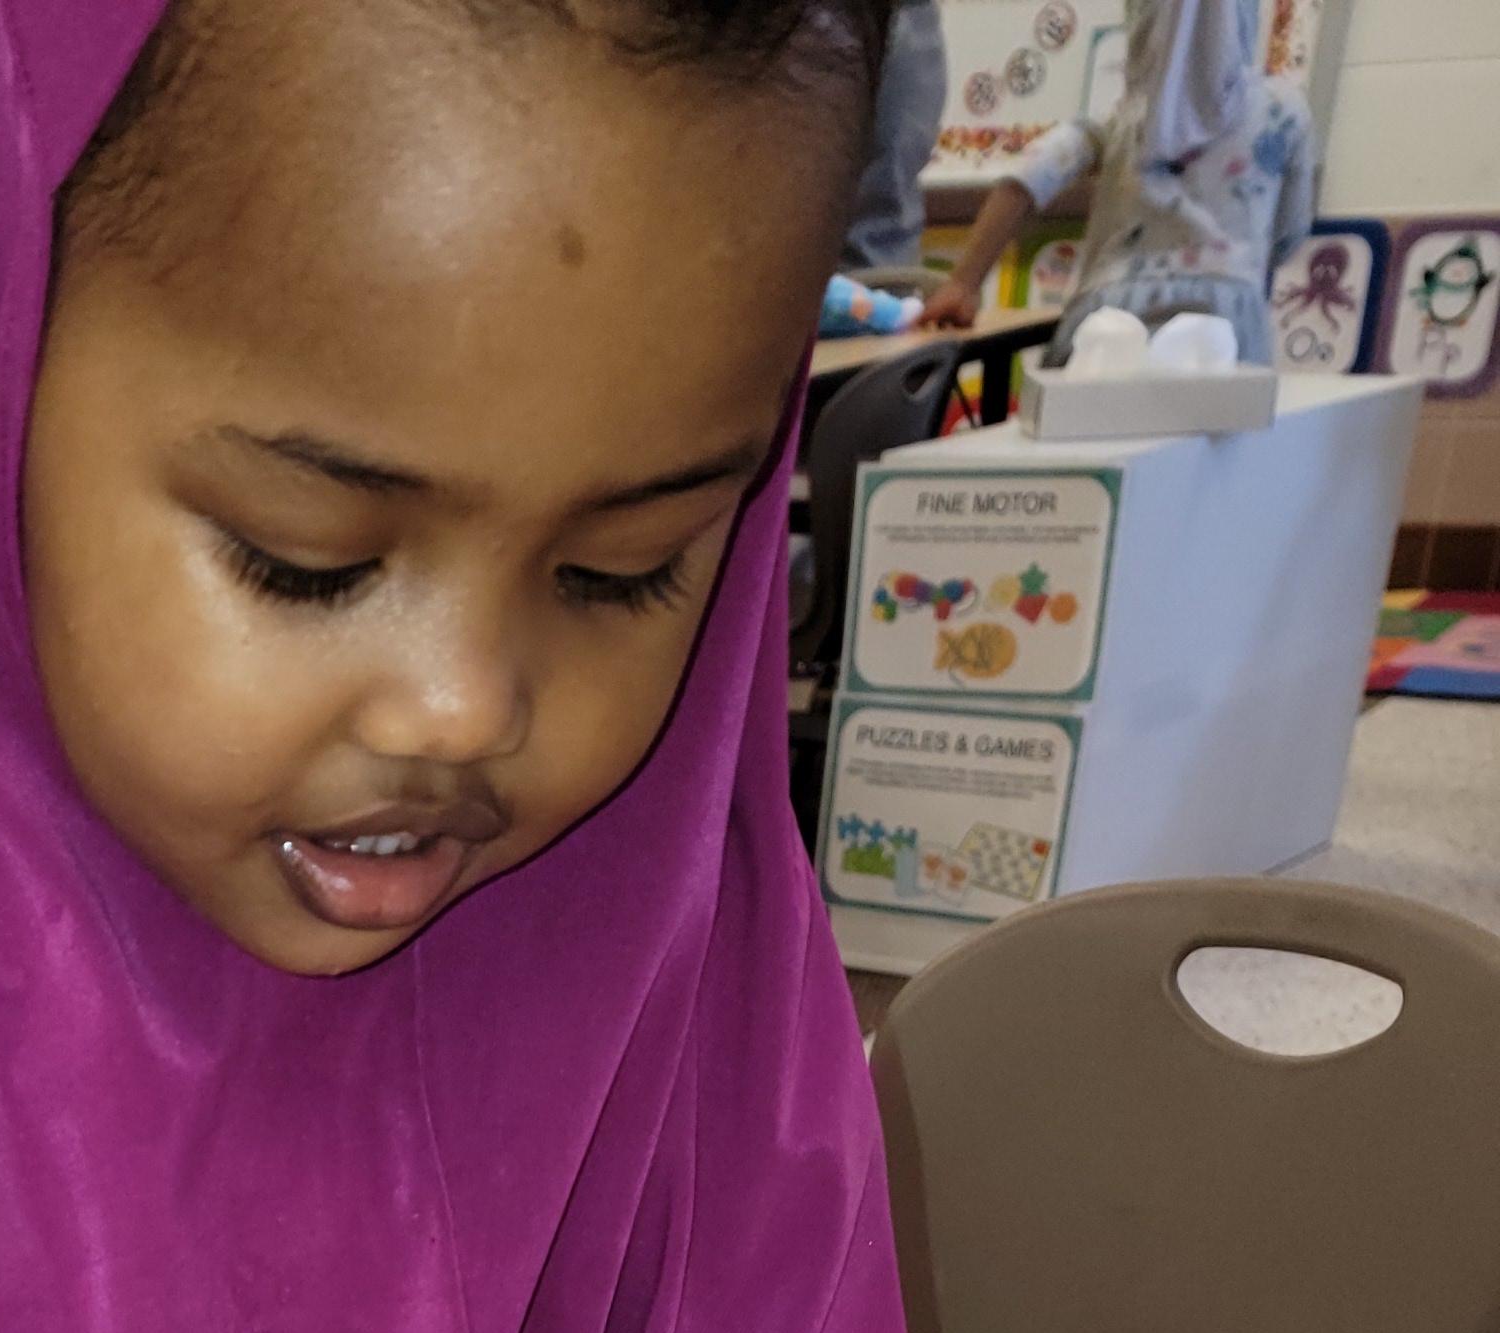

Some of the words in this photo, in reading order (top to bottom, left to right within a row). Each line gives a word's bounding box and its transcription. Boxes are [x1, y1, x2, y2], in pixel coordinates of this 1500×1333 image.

[916, 491, 968, 516] FINE
[972, 491, 1058, 516] MOTOR
[855, 723, 950, 754] PUZZLES
[954, 732, 970, 756] &
[973, 732, 1055, 763] GAMES
